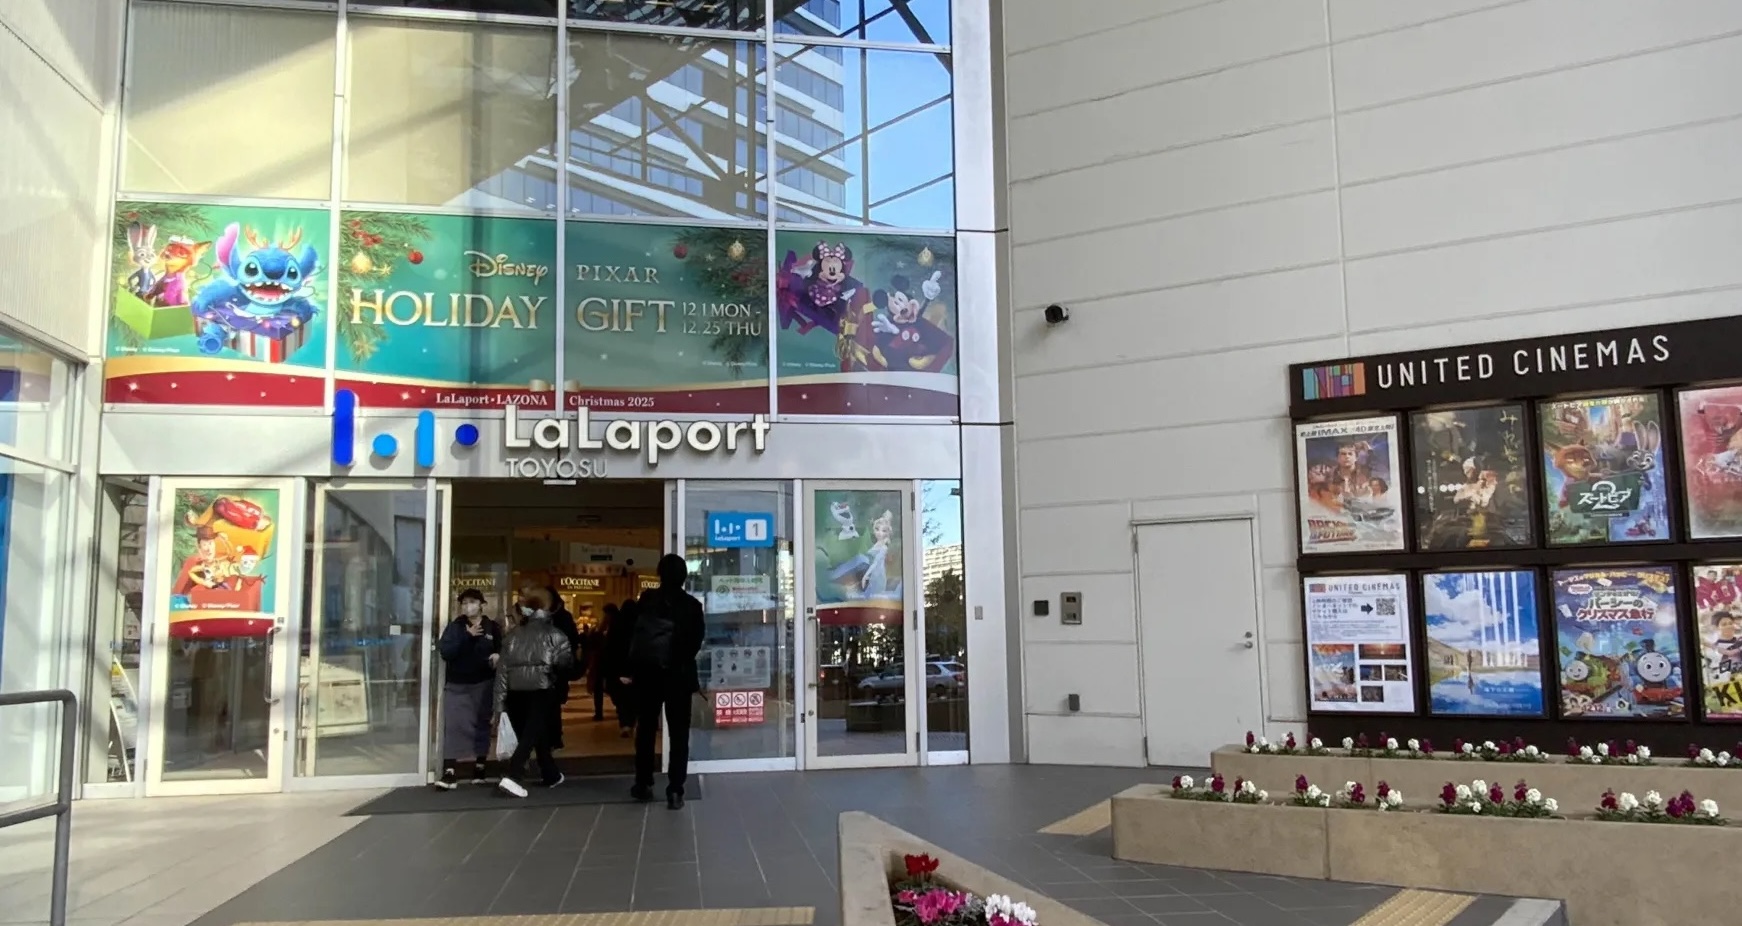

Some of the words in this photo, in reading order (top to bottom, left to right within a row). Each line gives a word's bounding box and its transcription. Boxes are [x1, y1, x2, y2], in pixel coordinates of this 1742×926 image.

[464, 250, 548, 286] Disney
[576, 264, 659, 284] PIXAR
[350, 288, 548, 331] HOLIDAY
[576, 296, 676, 334] GIFT
[711, 303, 751, 318] MON
[725, 321, 762, 336] THU
[1377, 353, 1494, 389] UNITED
[1514, 335, 1670, 375] CINEMAS
[569, 395, 625, 407] Christmas
[627, 396, 655, 408] 2025
[505, 404, 770, 467] LaLaport
[505, 457, 608, 478] TOYOSU
